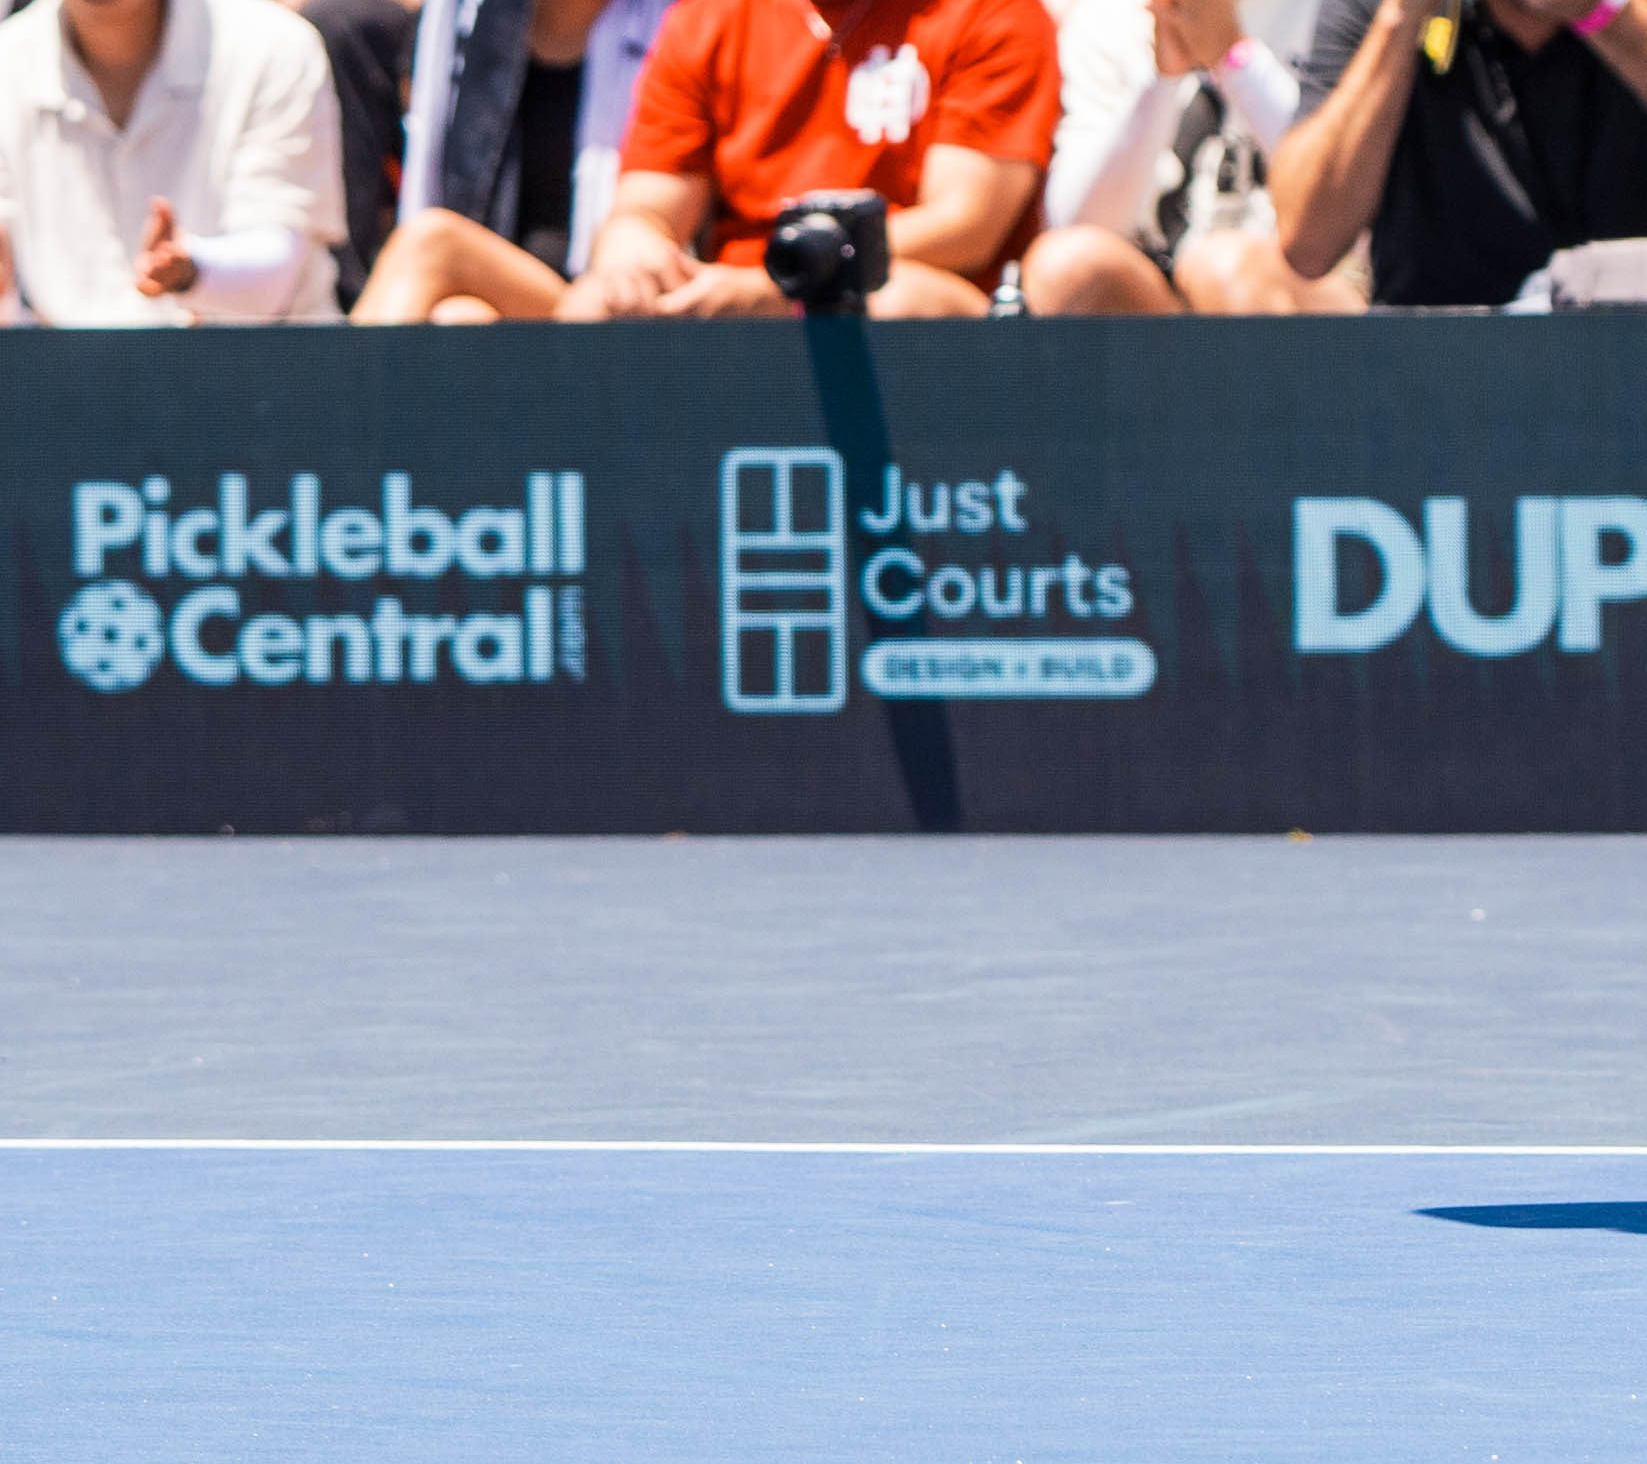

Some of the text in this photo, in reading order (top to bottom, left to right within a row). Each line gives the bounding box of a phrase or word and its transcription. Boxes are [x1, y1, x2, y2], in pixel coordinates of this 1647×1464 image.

[71, 471, 587, 578] Pickleball
[859, 463, 1029, 534] Just
[860, 546, 1135, 619] Courts
[168, 584, 555, 684] Central
